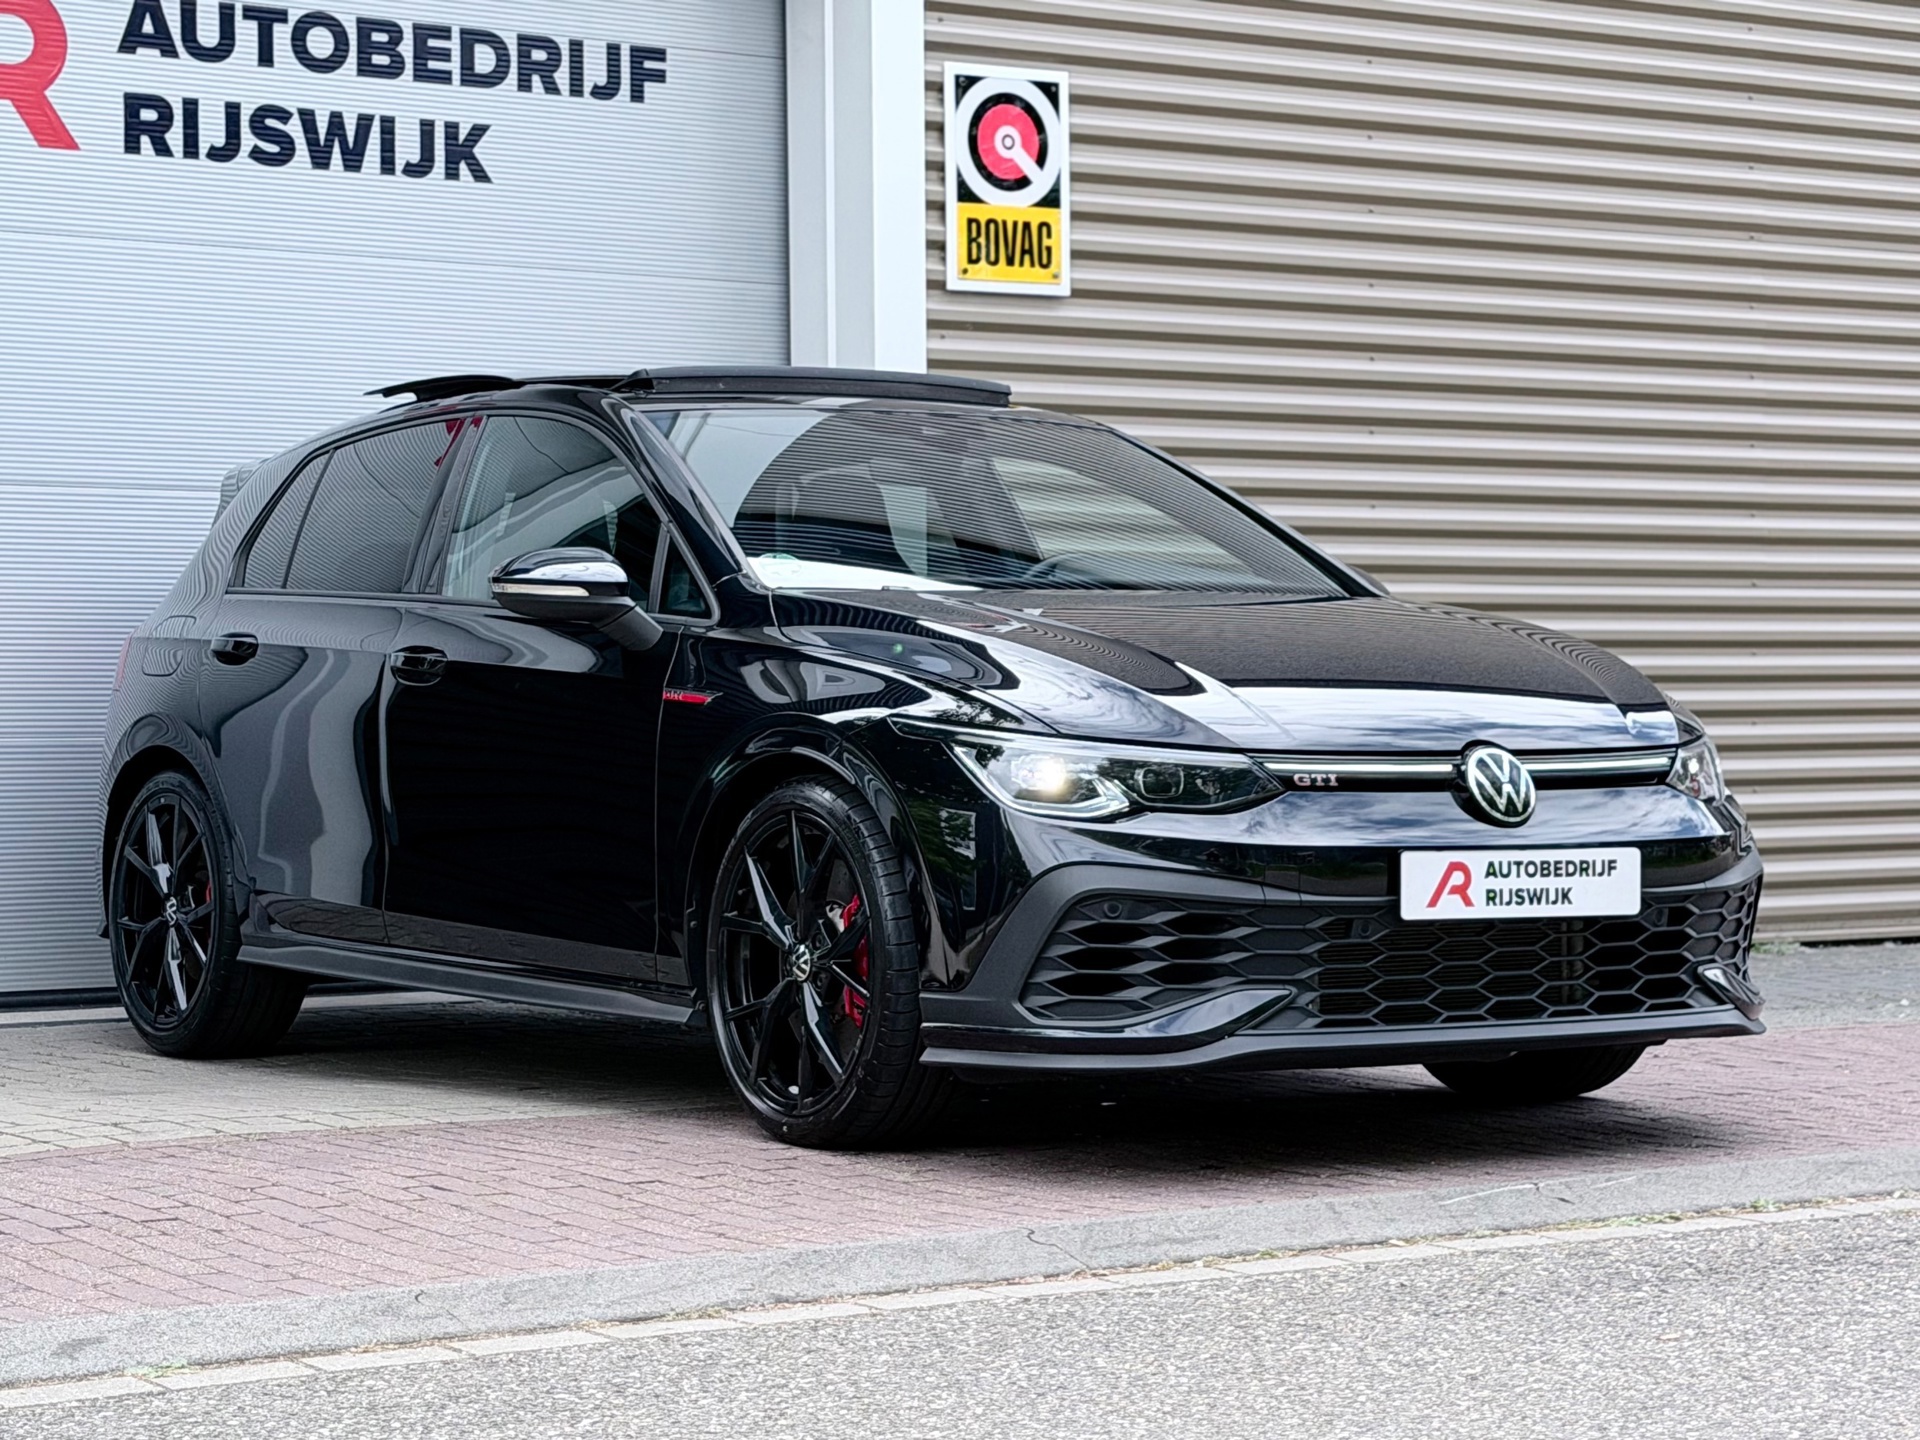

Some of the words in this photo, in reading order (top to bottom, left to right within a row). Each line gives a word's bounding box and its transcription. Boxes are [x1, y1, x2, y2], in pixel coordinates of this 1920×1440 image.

[117, 0, 667, 103] AUTOBEDRIJF
[123, 92, 494, 184] RIJSWIJK
[966, 217, 1052, 270] BOVAG
[1292, 772, 1339, 787] GTI
[1484, 859, 1618, 879] AUTOBEDRIJF
[1485, 887, 1573, 907] RIJSWIJK
